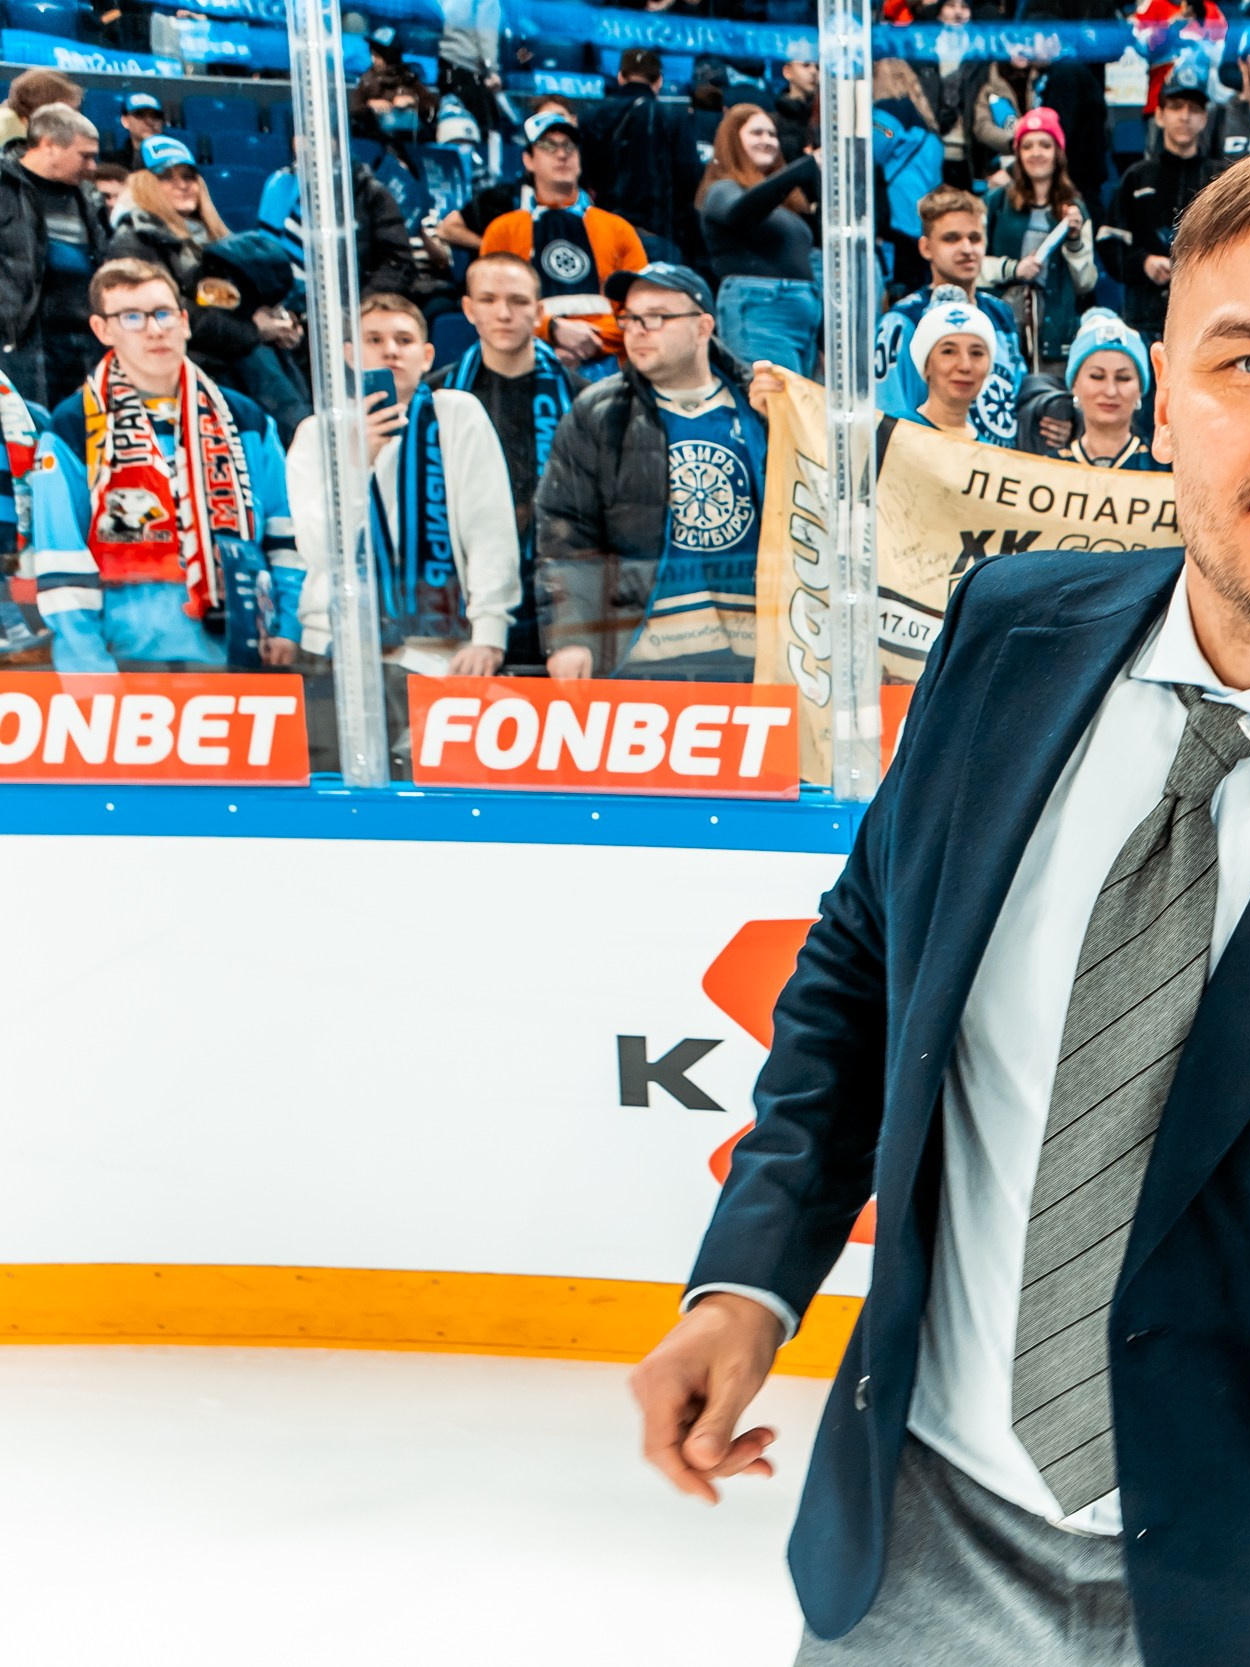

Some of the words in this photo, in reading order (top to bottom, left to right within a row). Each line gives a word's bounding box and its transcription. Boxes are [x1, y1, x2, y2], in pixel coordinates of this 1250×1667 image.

[669, 445, 735, 476] ИБИРЬ
[672, 495, 751, 547] ОСИБИРСК
[962, 469, 1179, 534] ЛЕОПАРД
[0, 692, 297, 766] ONBET
[419, 697, 791, 778] FONBET
